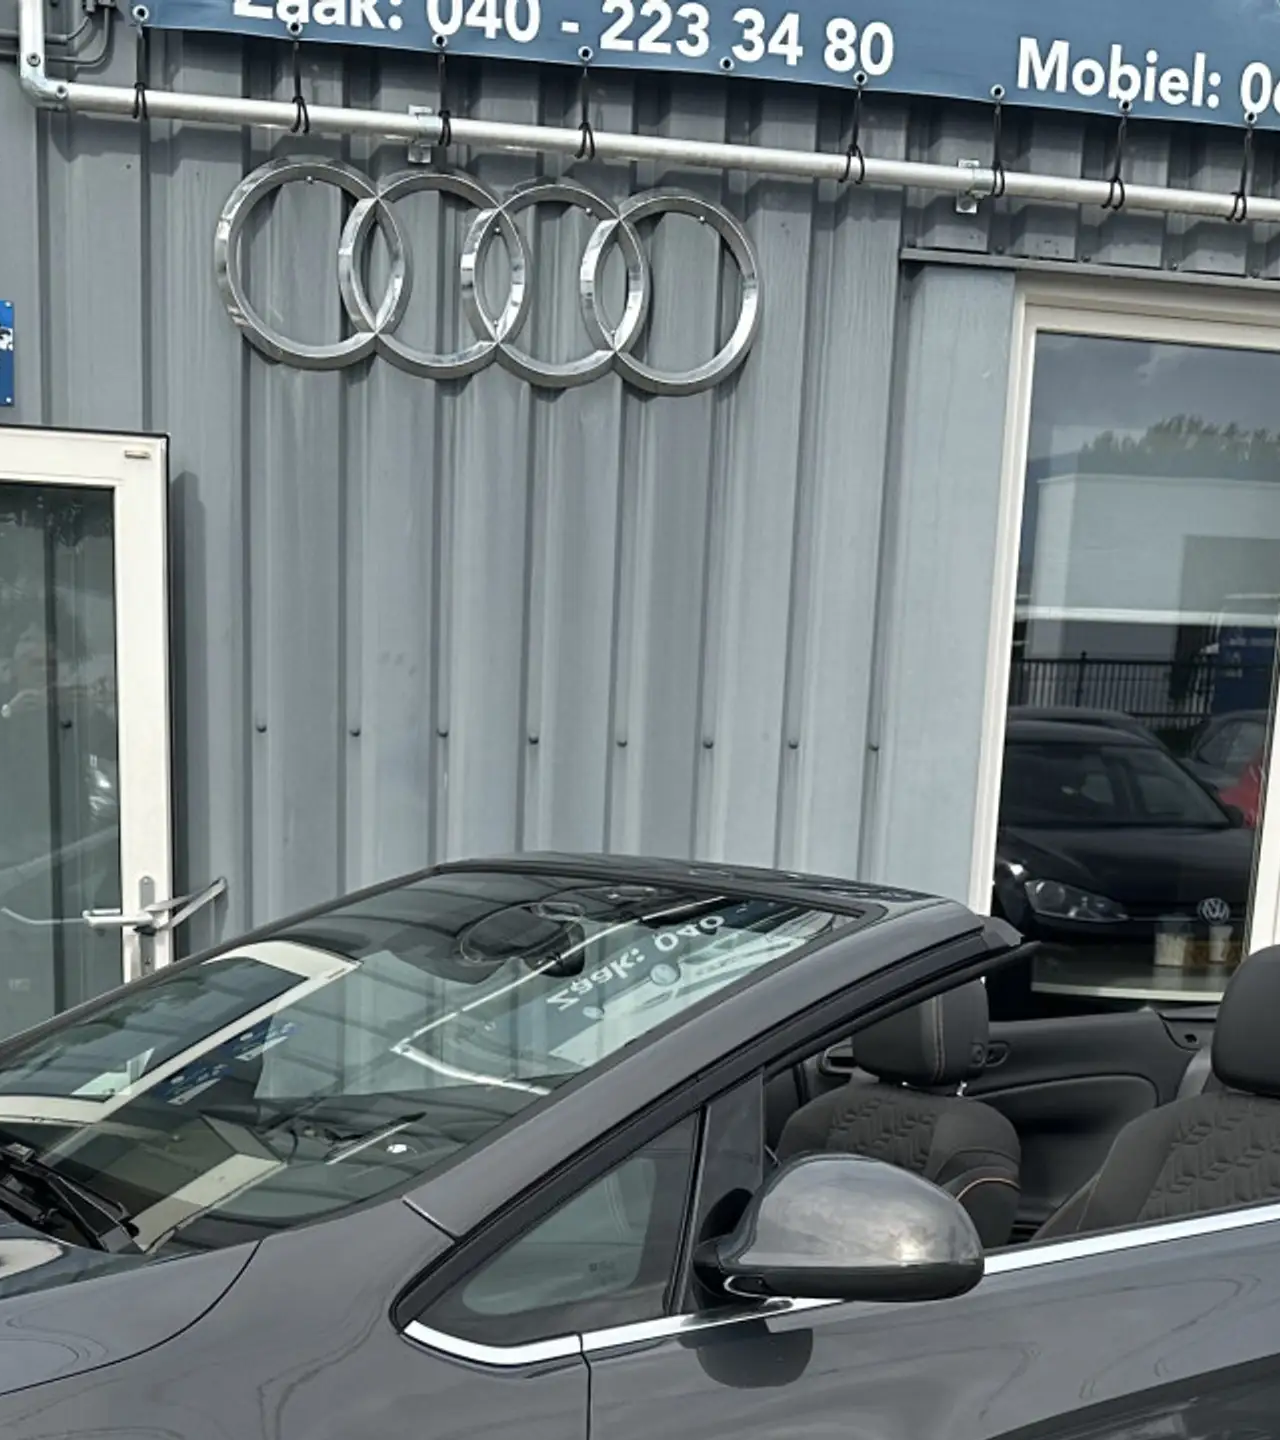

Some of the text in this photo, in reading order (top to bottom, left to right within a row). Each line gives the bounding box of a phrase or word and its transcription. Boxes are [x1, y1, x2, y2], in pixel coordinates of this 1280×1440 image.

[426, 0, 542, 43] 040
[599, 0, 711, 58] 223
[731, 7, 804, 66] 34
[823, 17, 895, 76] 80
[1017, 36, 1222, 110] Mobiel:
